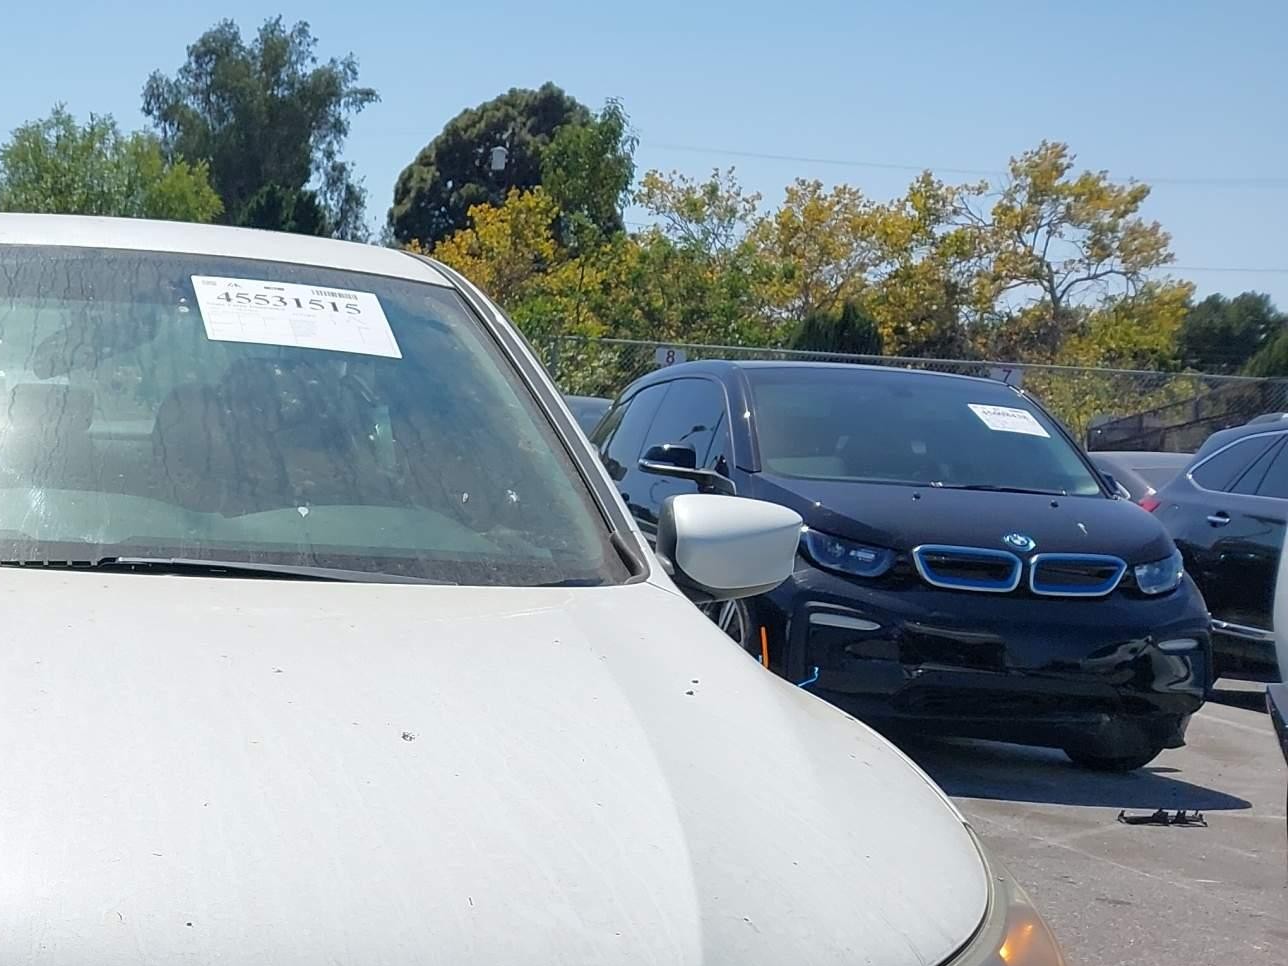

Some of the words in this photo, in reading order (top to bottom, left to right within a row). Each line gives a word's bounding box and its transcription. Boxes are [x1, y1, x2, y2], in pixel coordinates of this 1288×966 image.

[216, 291, 362, 315] 45531515
[666, 350, 675, 364] 8
[1002, 369, 1012, 383] 7
